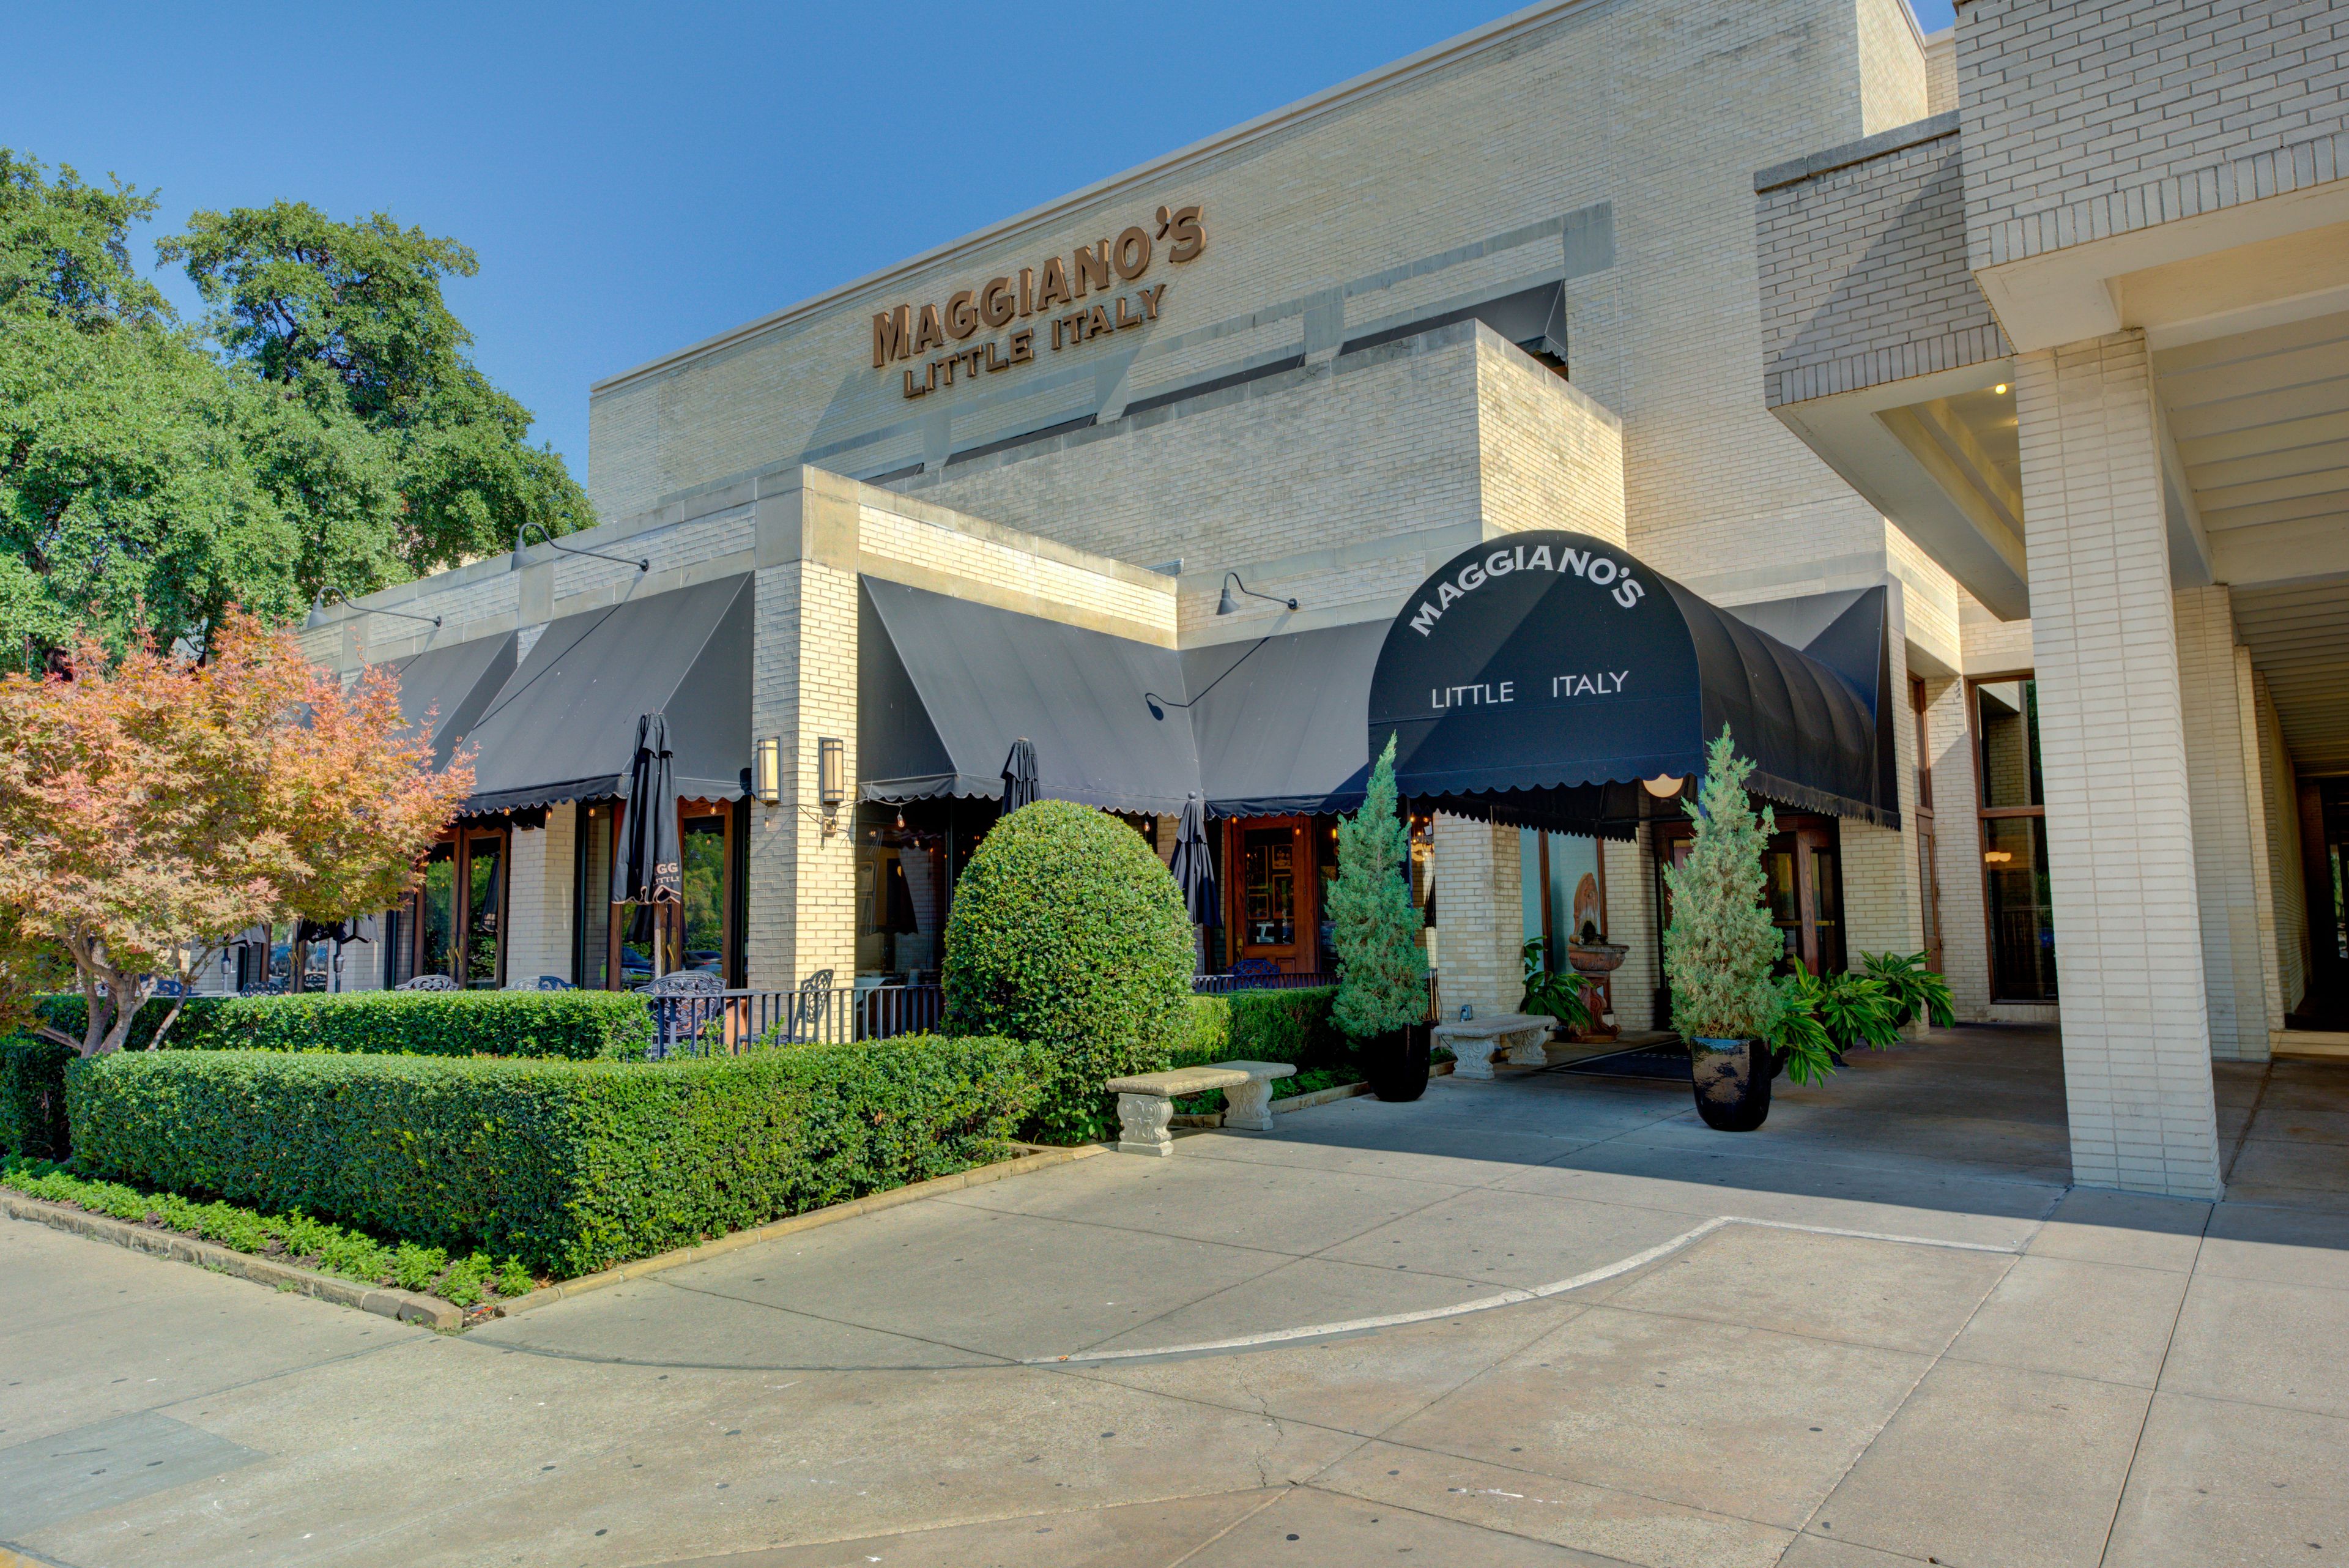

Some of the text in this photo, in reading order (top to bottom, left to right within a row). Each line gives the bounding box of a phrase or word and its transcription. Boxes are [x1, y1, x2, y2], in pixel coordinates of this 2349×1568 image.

[872, 206, 1206, 367] MAGGIANO'S
[903, 283, 1166, 398] LITTLE ITALY
[1409, 545, 1645, 637] MAGGIANO'S
[1432, 671, 1628, 708] LITTLE ITALY
